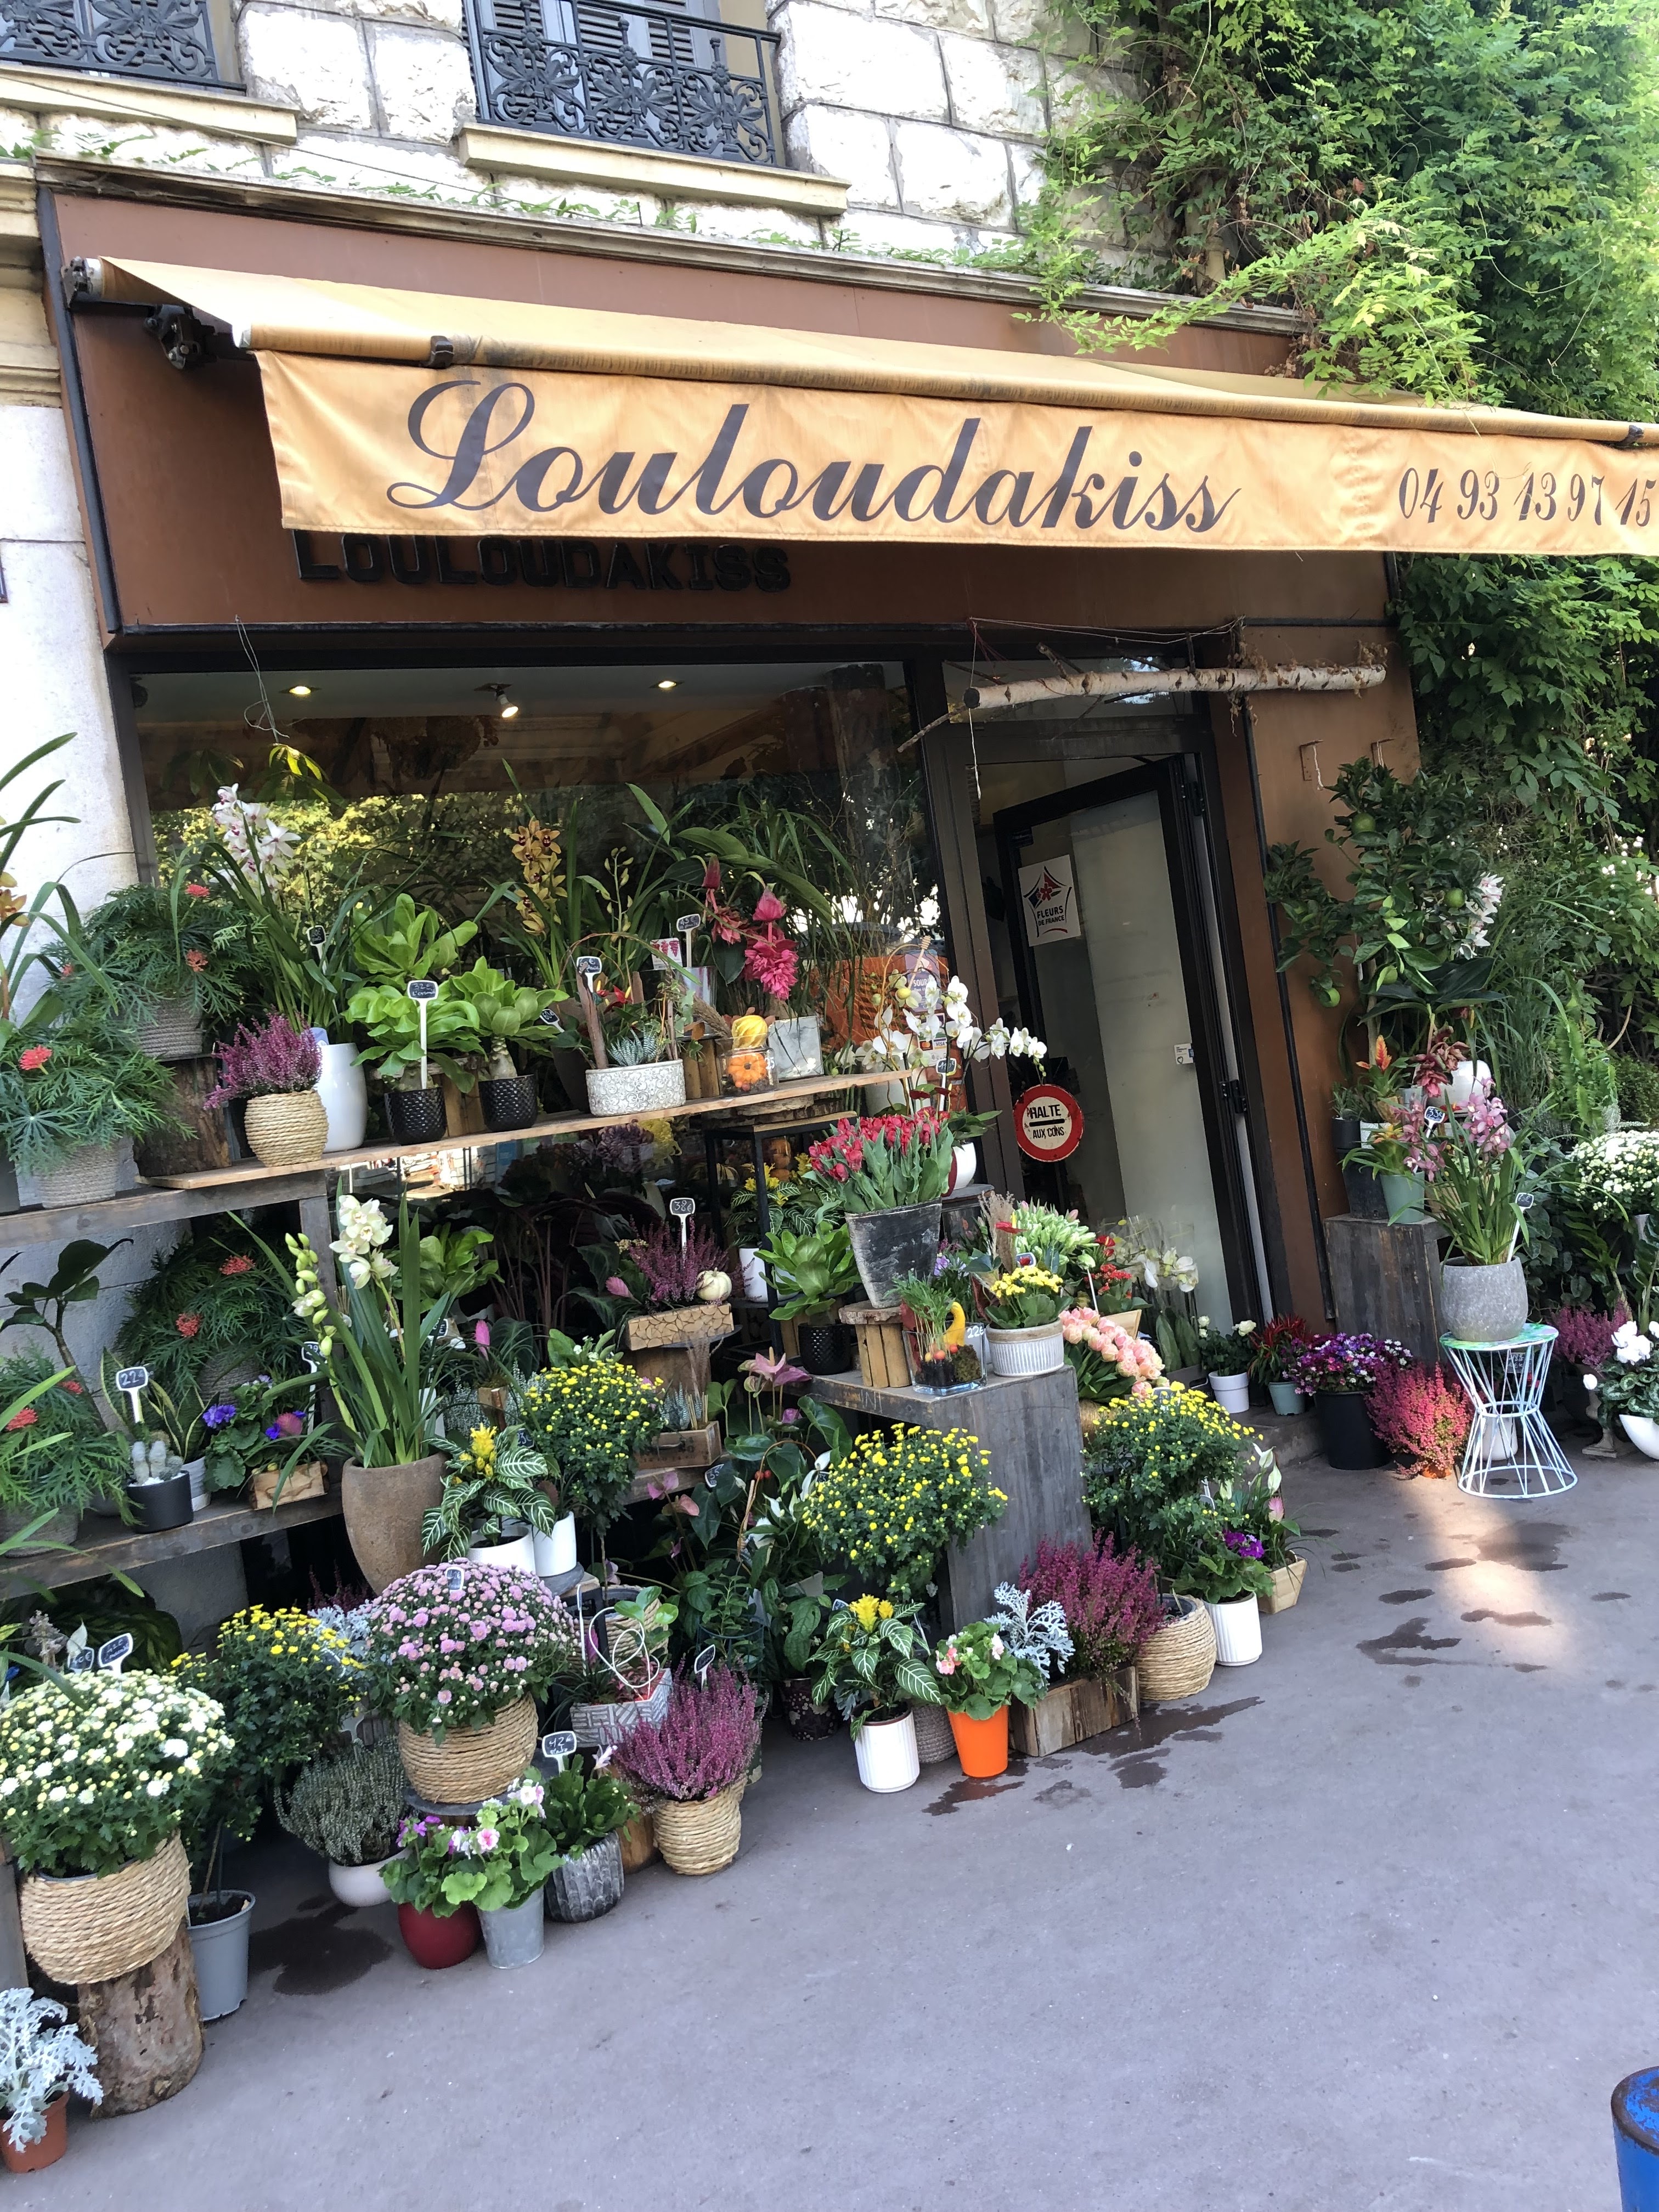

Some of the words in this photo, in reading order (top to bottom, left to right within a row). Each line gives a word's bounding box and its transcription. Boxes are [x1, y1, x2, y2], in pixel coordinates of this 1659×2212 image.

[387, 380, 1241, 533] Louloudakiss
[1399, 467, 1444, 523] 04
[1457, 469, 1500, 521] 93
[1514, 472, 1557, 521] 13
[1567, 473, 1605, 526] 97
[1615, 478, 1658, 527] 15
[292, 528, 791, 592] LOULOUDAKISS
[1037, 906, 1064, 919] FLEURS
[1045, 915, 1065, 925] FRANCE
[1030, 1104, 1062, 1119] HALTE
[1033, 1128, 1045, 1139] AUX
[1047, 1126, 1065, 1137] CONS
